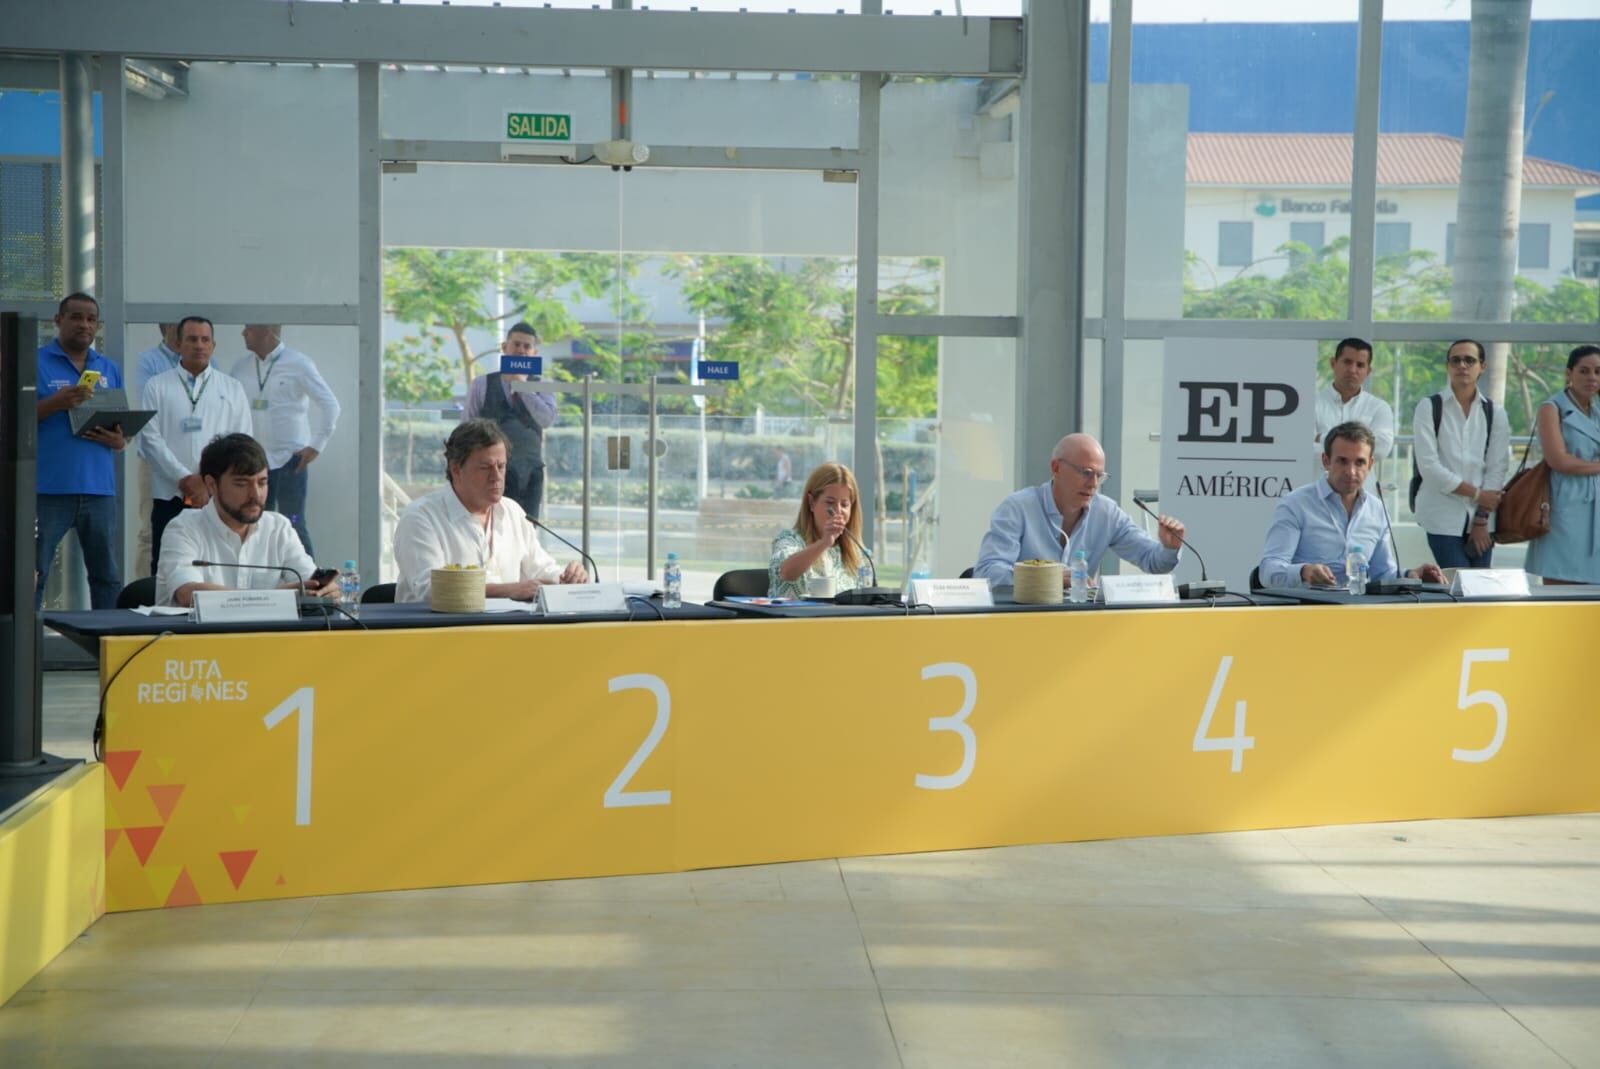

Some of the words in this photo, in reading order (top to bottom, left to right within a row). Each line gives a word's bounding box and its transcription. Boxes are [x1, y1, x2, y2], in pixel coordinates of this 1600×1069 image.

[508, 115, 569, 137] SALIDA
[1280, 199, 1327, 214] Banco
[1330, 199, 1398, 214] Fallla
[510, 360, 532, 369] HALE
[707, 366, 729, 375] HALE
[1177, 381, 1299, 444] EP
[1176, 470, 1294, 498] AMÉRICA
[164, 659, 222, 680] RUTA
[914, 661, 977, 790] 3
[1192, 655, 1255, 773] 4
[1451, 647, 1510, 763] 5
[263, 686, 315, 826] 1
[603, 673, 671, 808] 2
